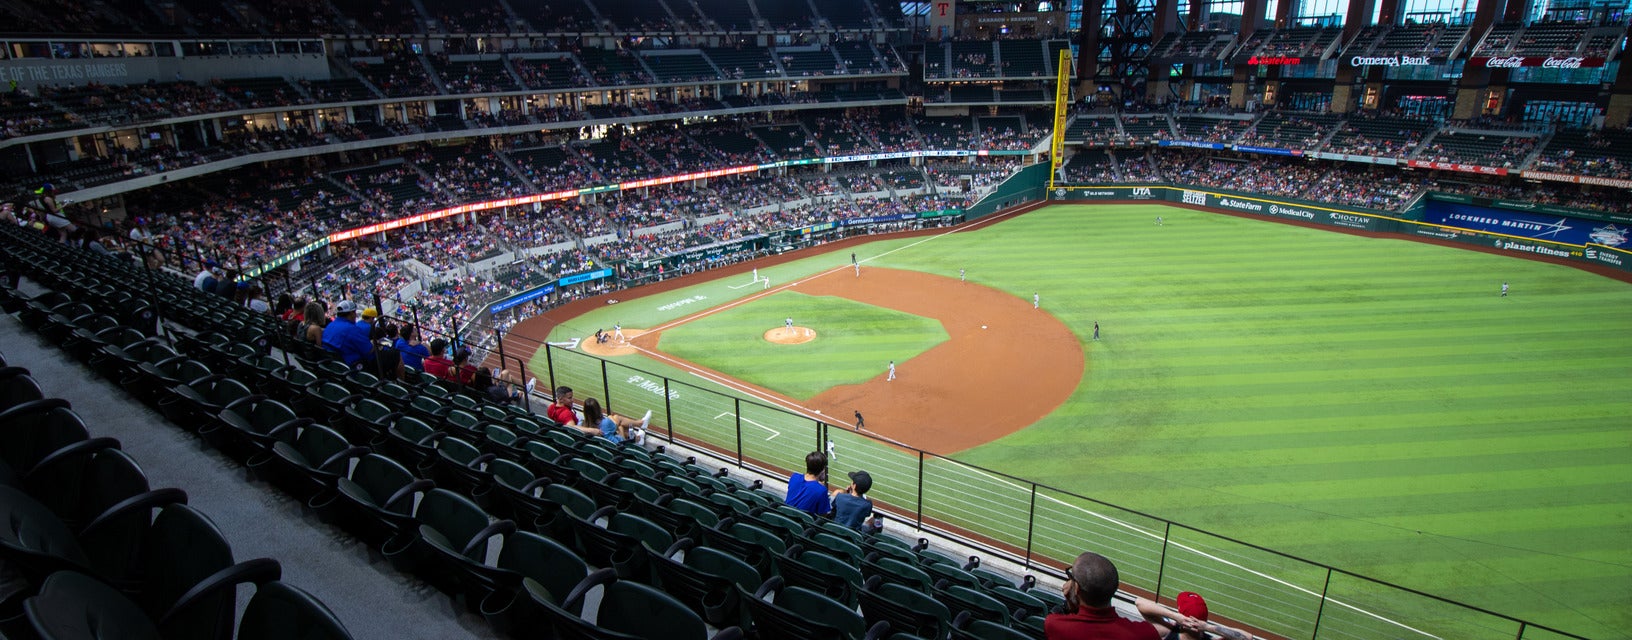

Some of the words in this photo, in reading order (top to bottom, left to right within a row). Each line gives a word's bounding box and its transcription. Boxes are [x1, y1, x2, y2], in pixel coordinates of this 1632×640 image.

[938, 2, 949, 16] T
[1401, 56, 1430, 65] Bank
[10, 66, 24, 82] OF
[27, 65, 49, 81] THE
[50, 64, 83, 80] TEXAS
[85, 63, 127, 78] RANGERS
[1523, 171, 1575, 183] WHATABURGER
[1132, 187, 1151, 196] UTA
[1182, 194, 1206, 206] SELTZER
[1279, 207, 1302, 217] Medical
[1302, 211, 1315, 220] City
[1333, 213, 1370, 224] CHOCTAW
[848, 217, 874, 225] Germania
[1449, 213, 1499, 225] LOCKHEED
[1501, 220, 1542, 231] MARTIN
[1504, 241, 1535, 252] planet
[1536, 245, 1569, 258] fitness
[1599, 251, 1619, 260] ENERGY
[1599, 256, 1622, 266] TRANSFER
